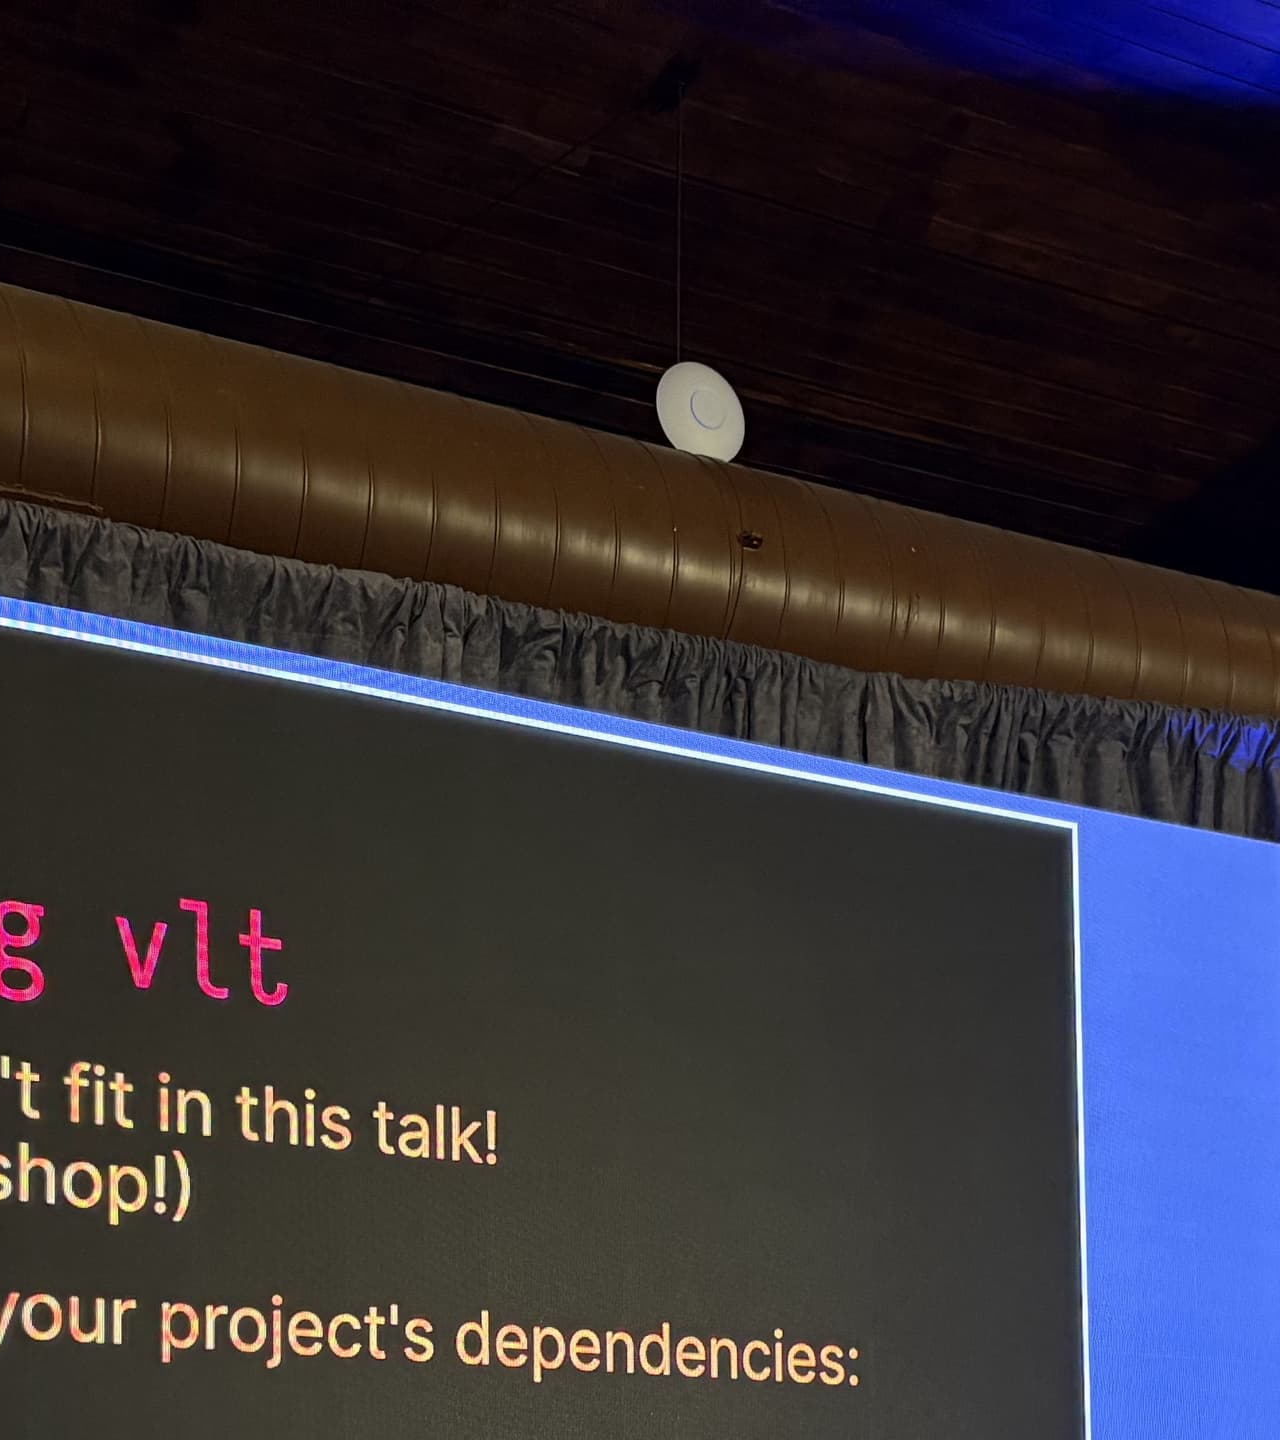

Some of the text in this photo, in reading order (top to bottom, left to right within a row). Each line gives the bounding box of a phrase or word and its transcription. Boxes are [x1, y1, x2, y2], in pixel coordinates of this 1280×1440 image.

[115, 897, 289, 1006] vlt
[63, 1061, 134, 1129] fit
[158, 1071, 212, 1137] in
[235, 1085, 352, 1151] this
[372, 1101, 497, 1165] talk!
[161, 1294, 435, 1369] project's
[455, 1309, 859, 1387] dependencies:
